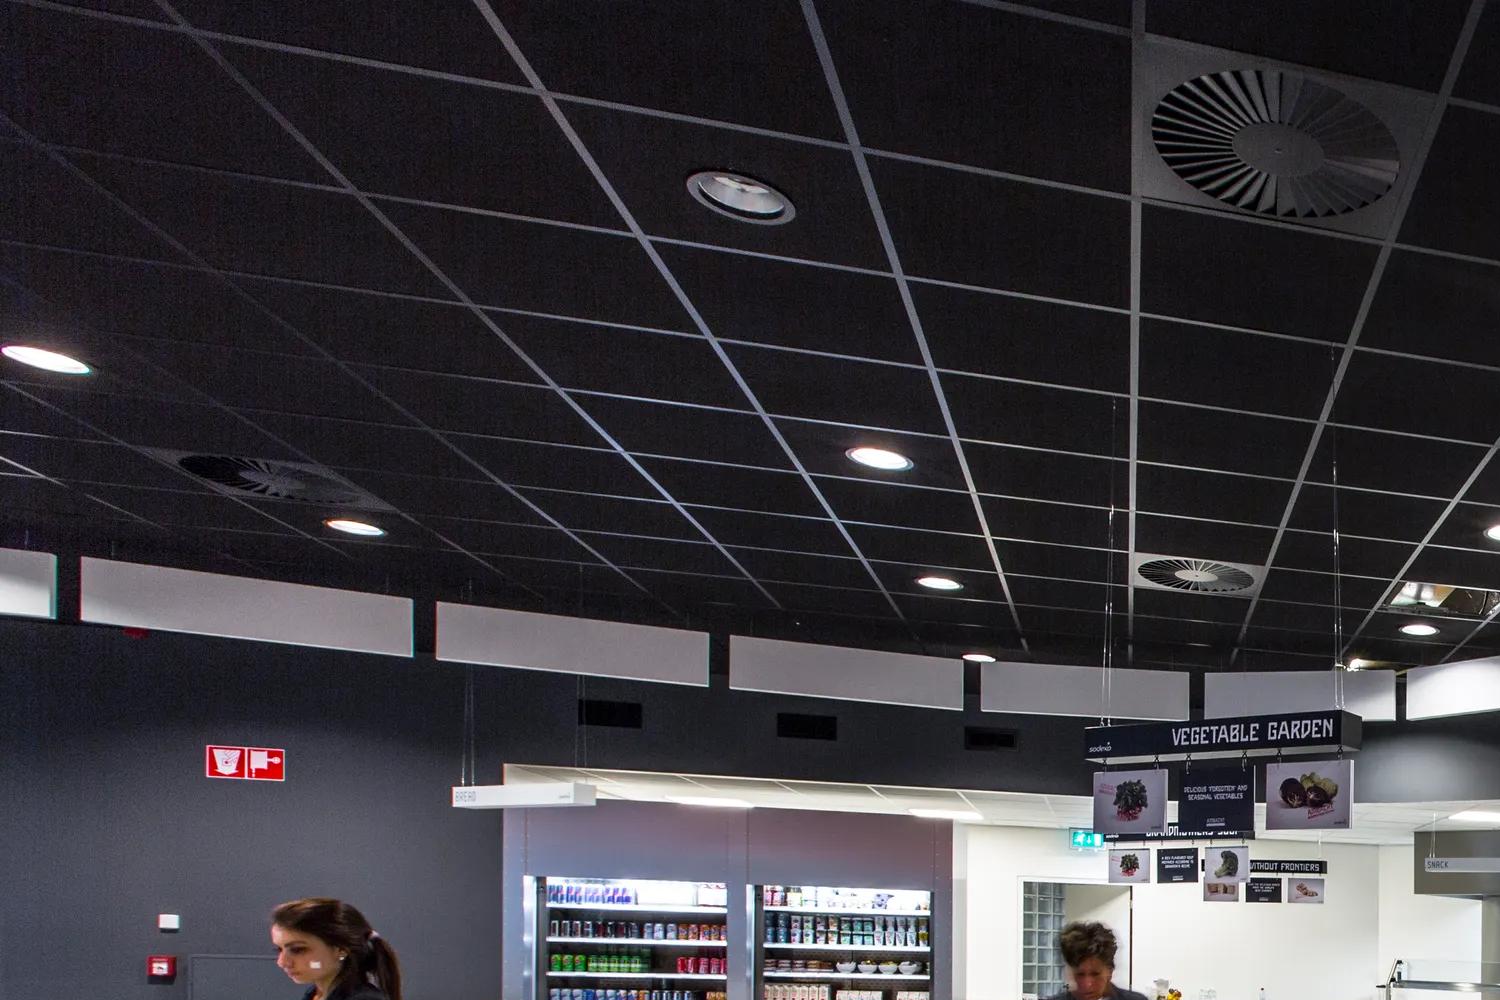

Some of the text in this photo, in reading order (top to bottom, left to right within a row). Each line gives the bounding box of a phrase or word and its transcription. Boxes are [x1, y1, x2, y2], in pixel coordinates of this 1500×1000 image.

[1172, 719, 1334, 746] VEGETABLE GARDEN
[1280, 862, 1320, 872] FRONTIERS
[1427, 861, 1449, 869] SNACK
